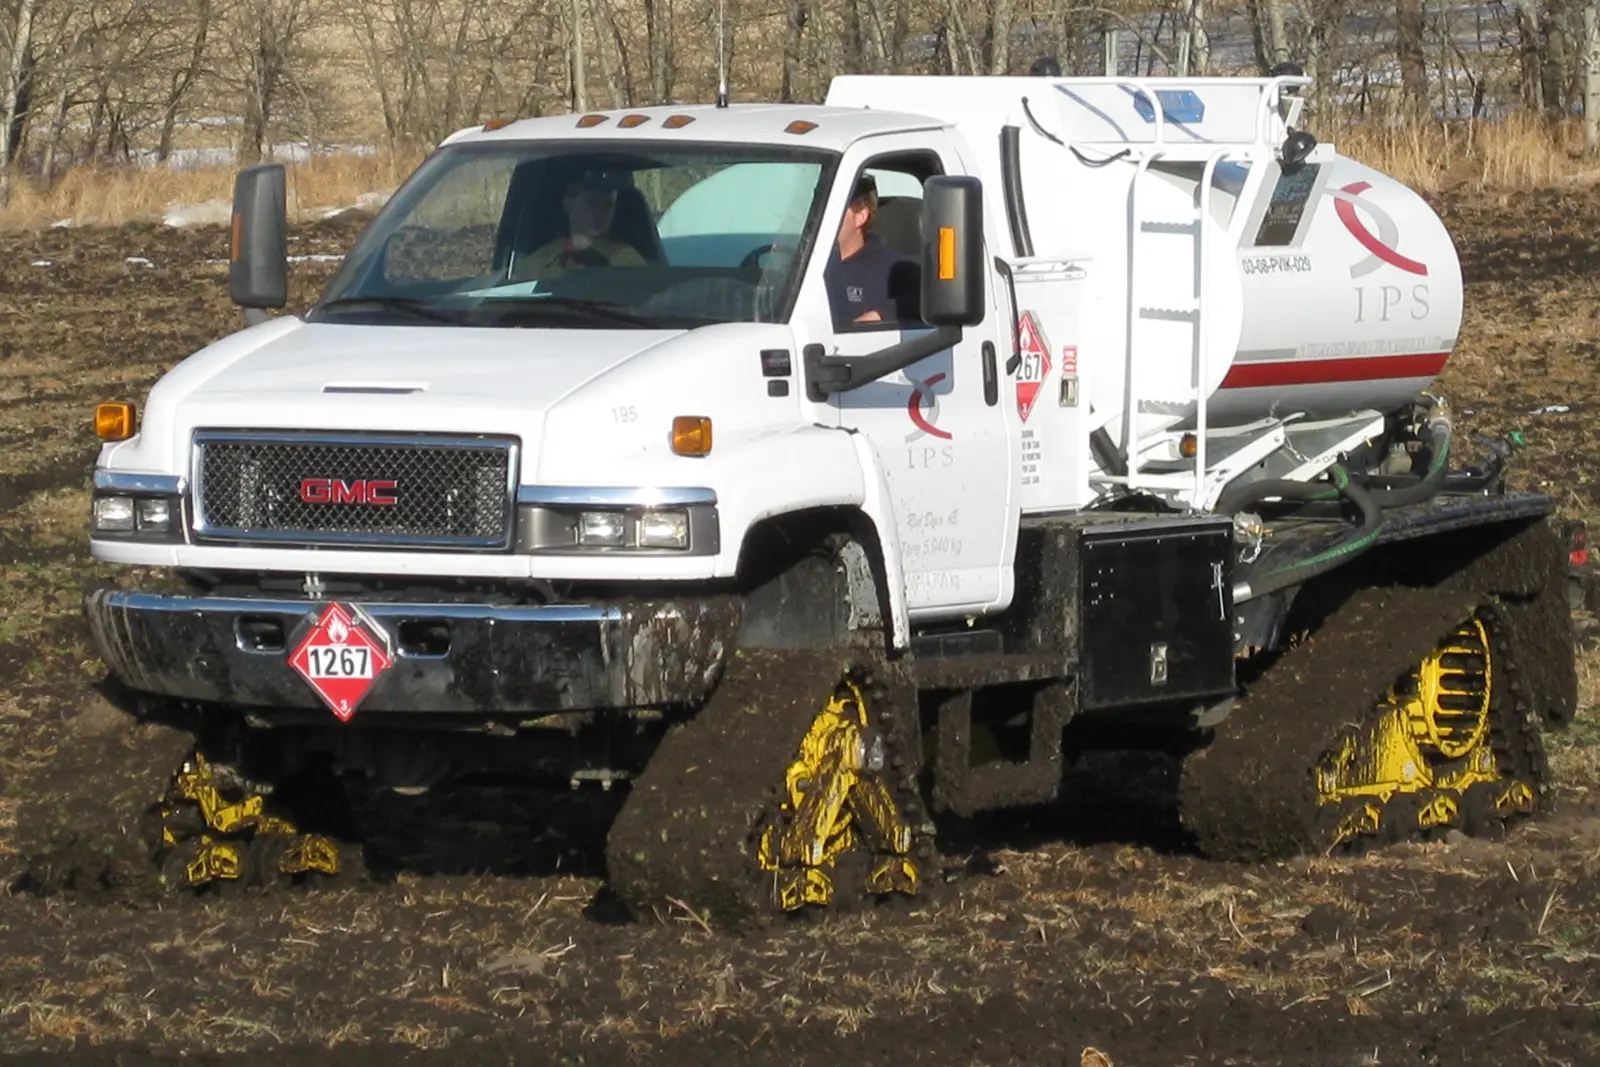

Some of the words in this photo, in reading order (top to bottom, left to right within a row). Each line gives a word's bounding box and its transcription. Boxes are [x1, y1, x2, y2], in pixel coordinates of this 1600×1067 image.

[1353, 284, 1431, 323] IPS
[1015, 354, 1040, 380] 267
[611, 405, 637, 422] 195
[905, 446, 954, 470] IPS
[301, 478, 398, 504] GMC
[310, 648, 368, 676] 1267
[340, 700, 348, 711] 3
